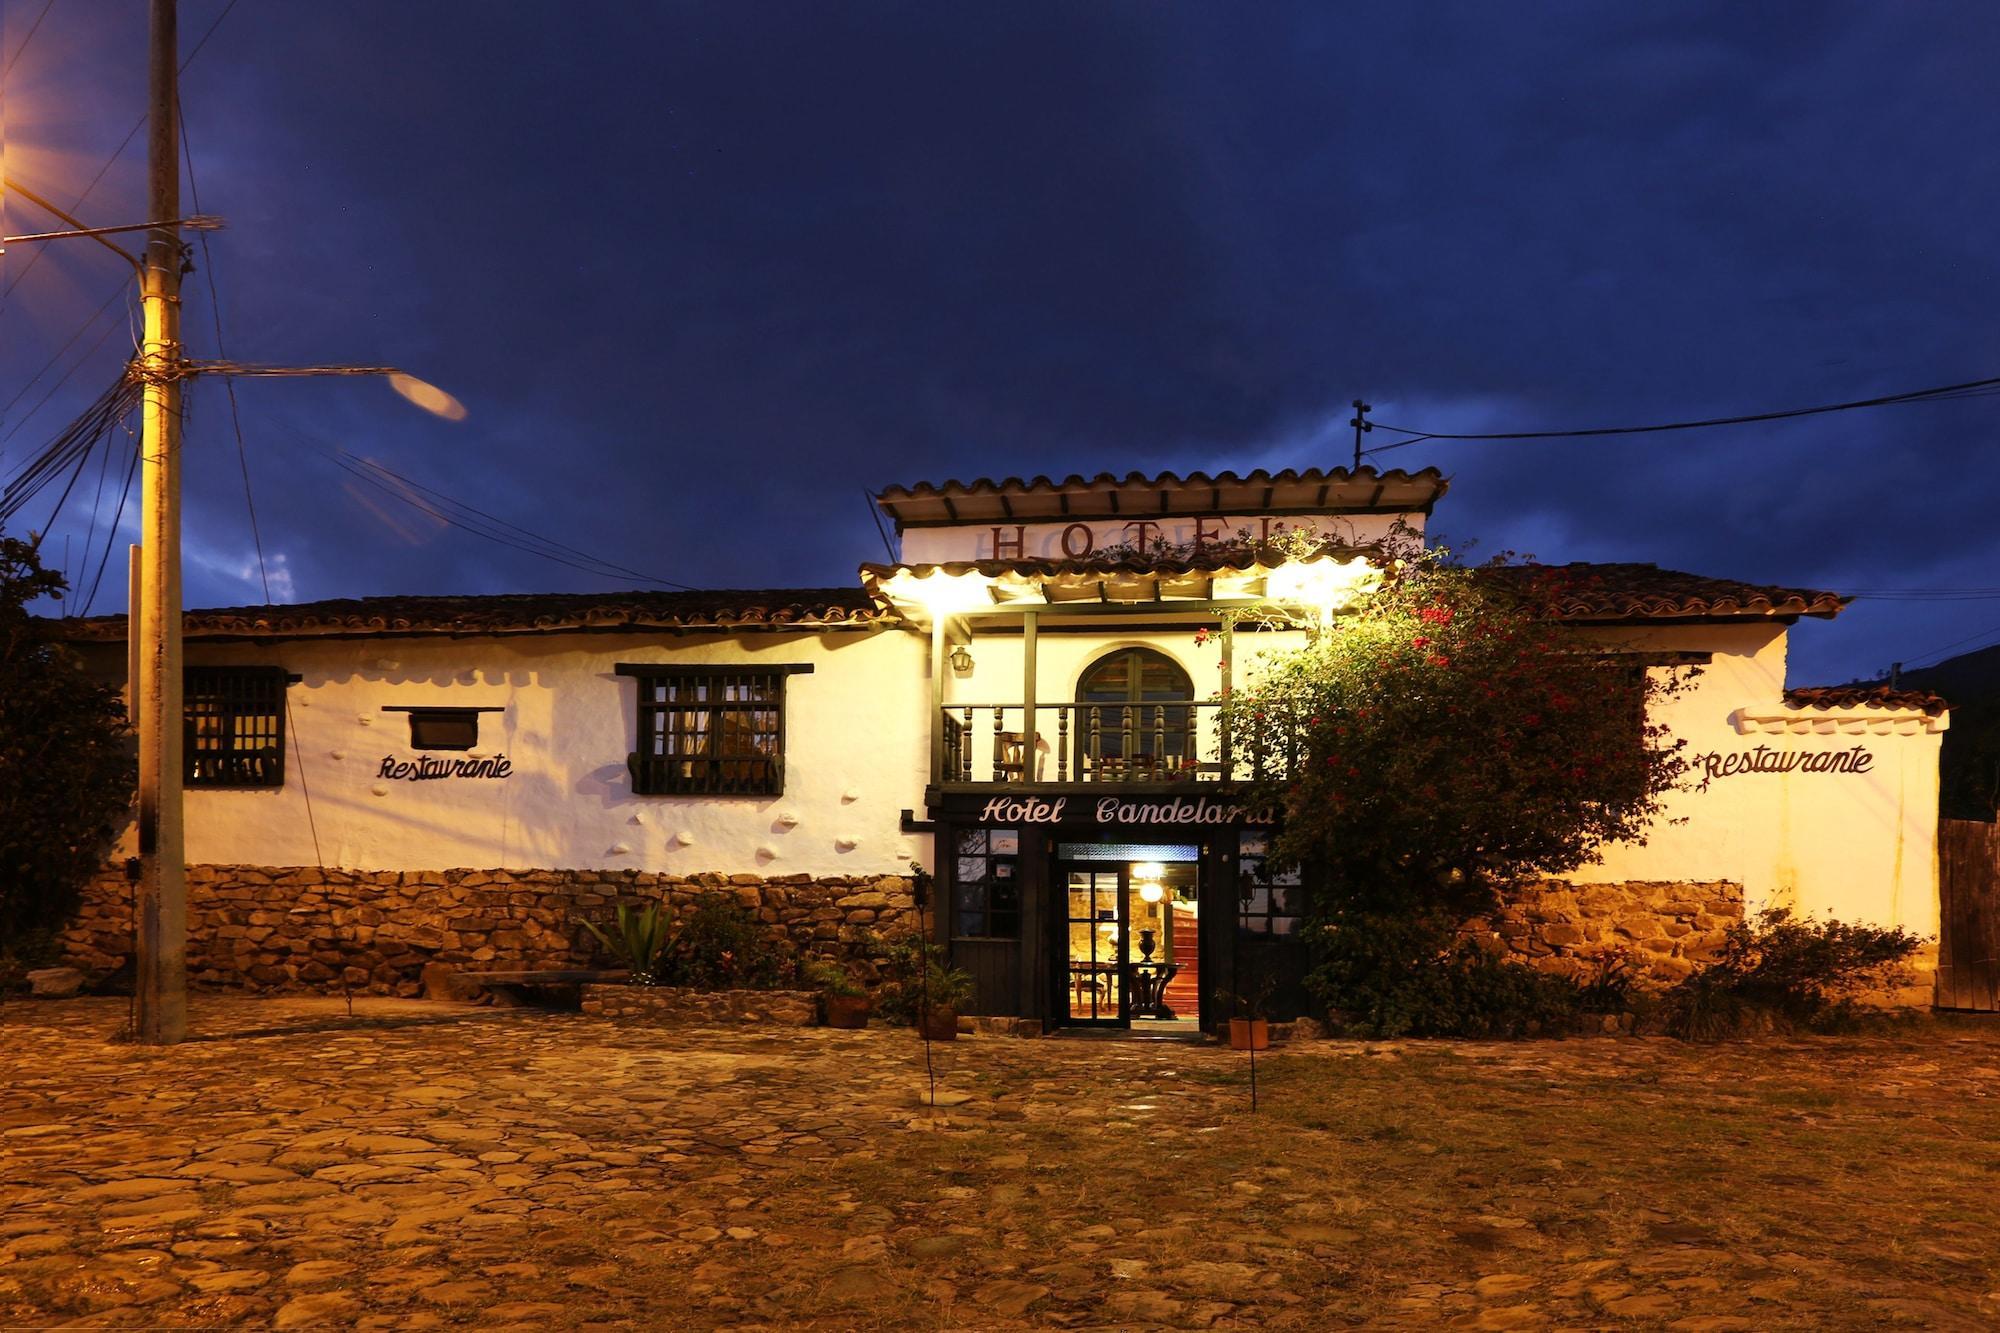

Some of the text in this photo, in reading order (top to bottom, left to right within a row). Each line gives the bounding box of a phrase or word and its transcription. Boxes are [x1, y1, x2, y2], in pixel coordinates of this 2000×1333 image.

[377, 753, 513, 781] Restaurante
[1705, 744, 1874, 779] Restaurante
[979, 796, 1067, 824] Hotel
